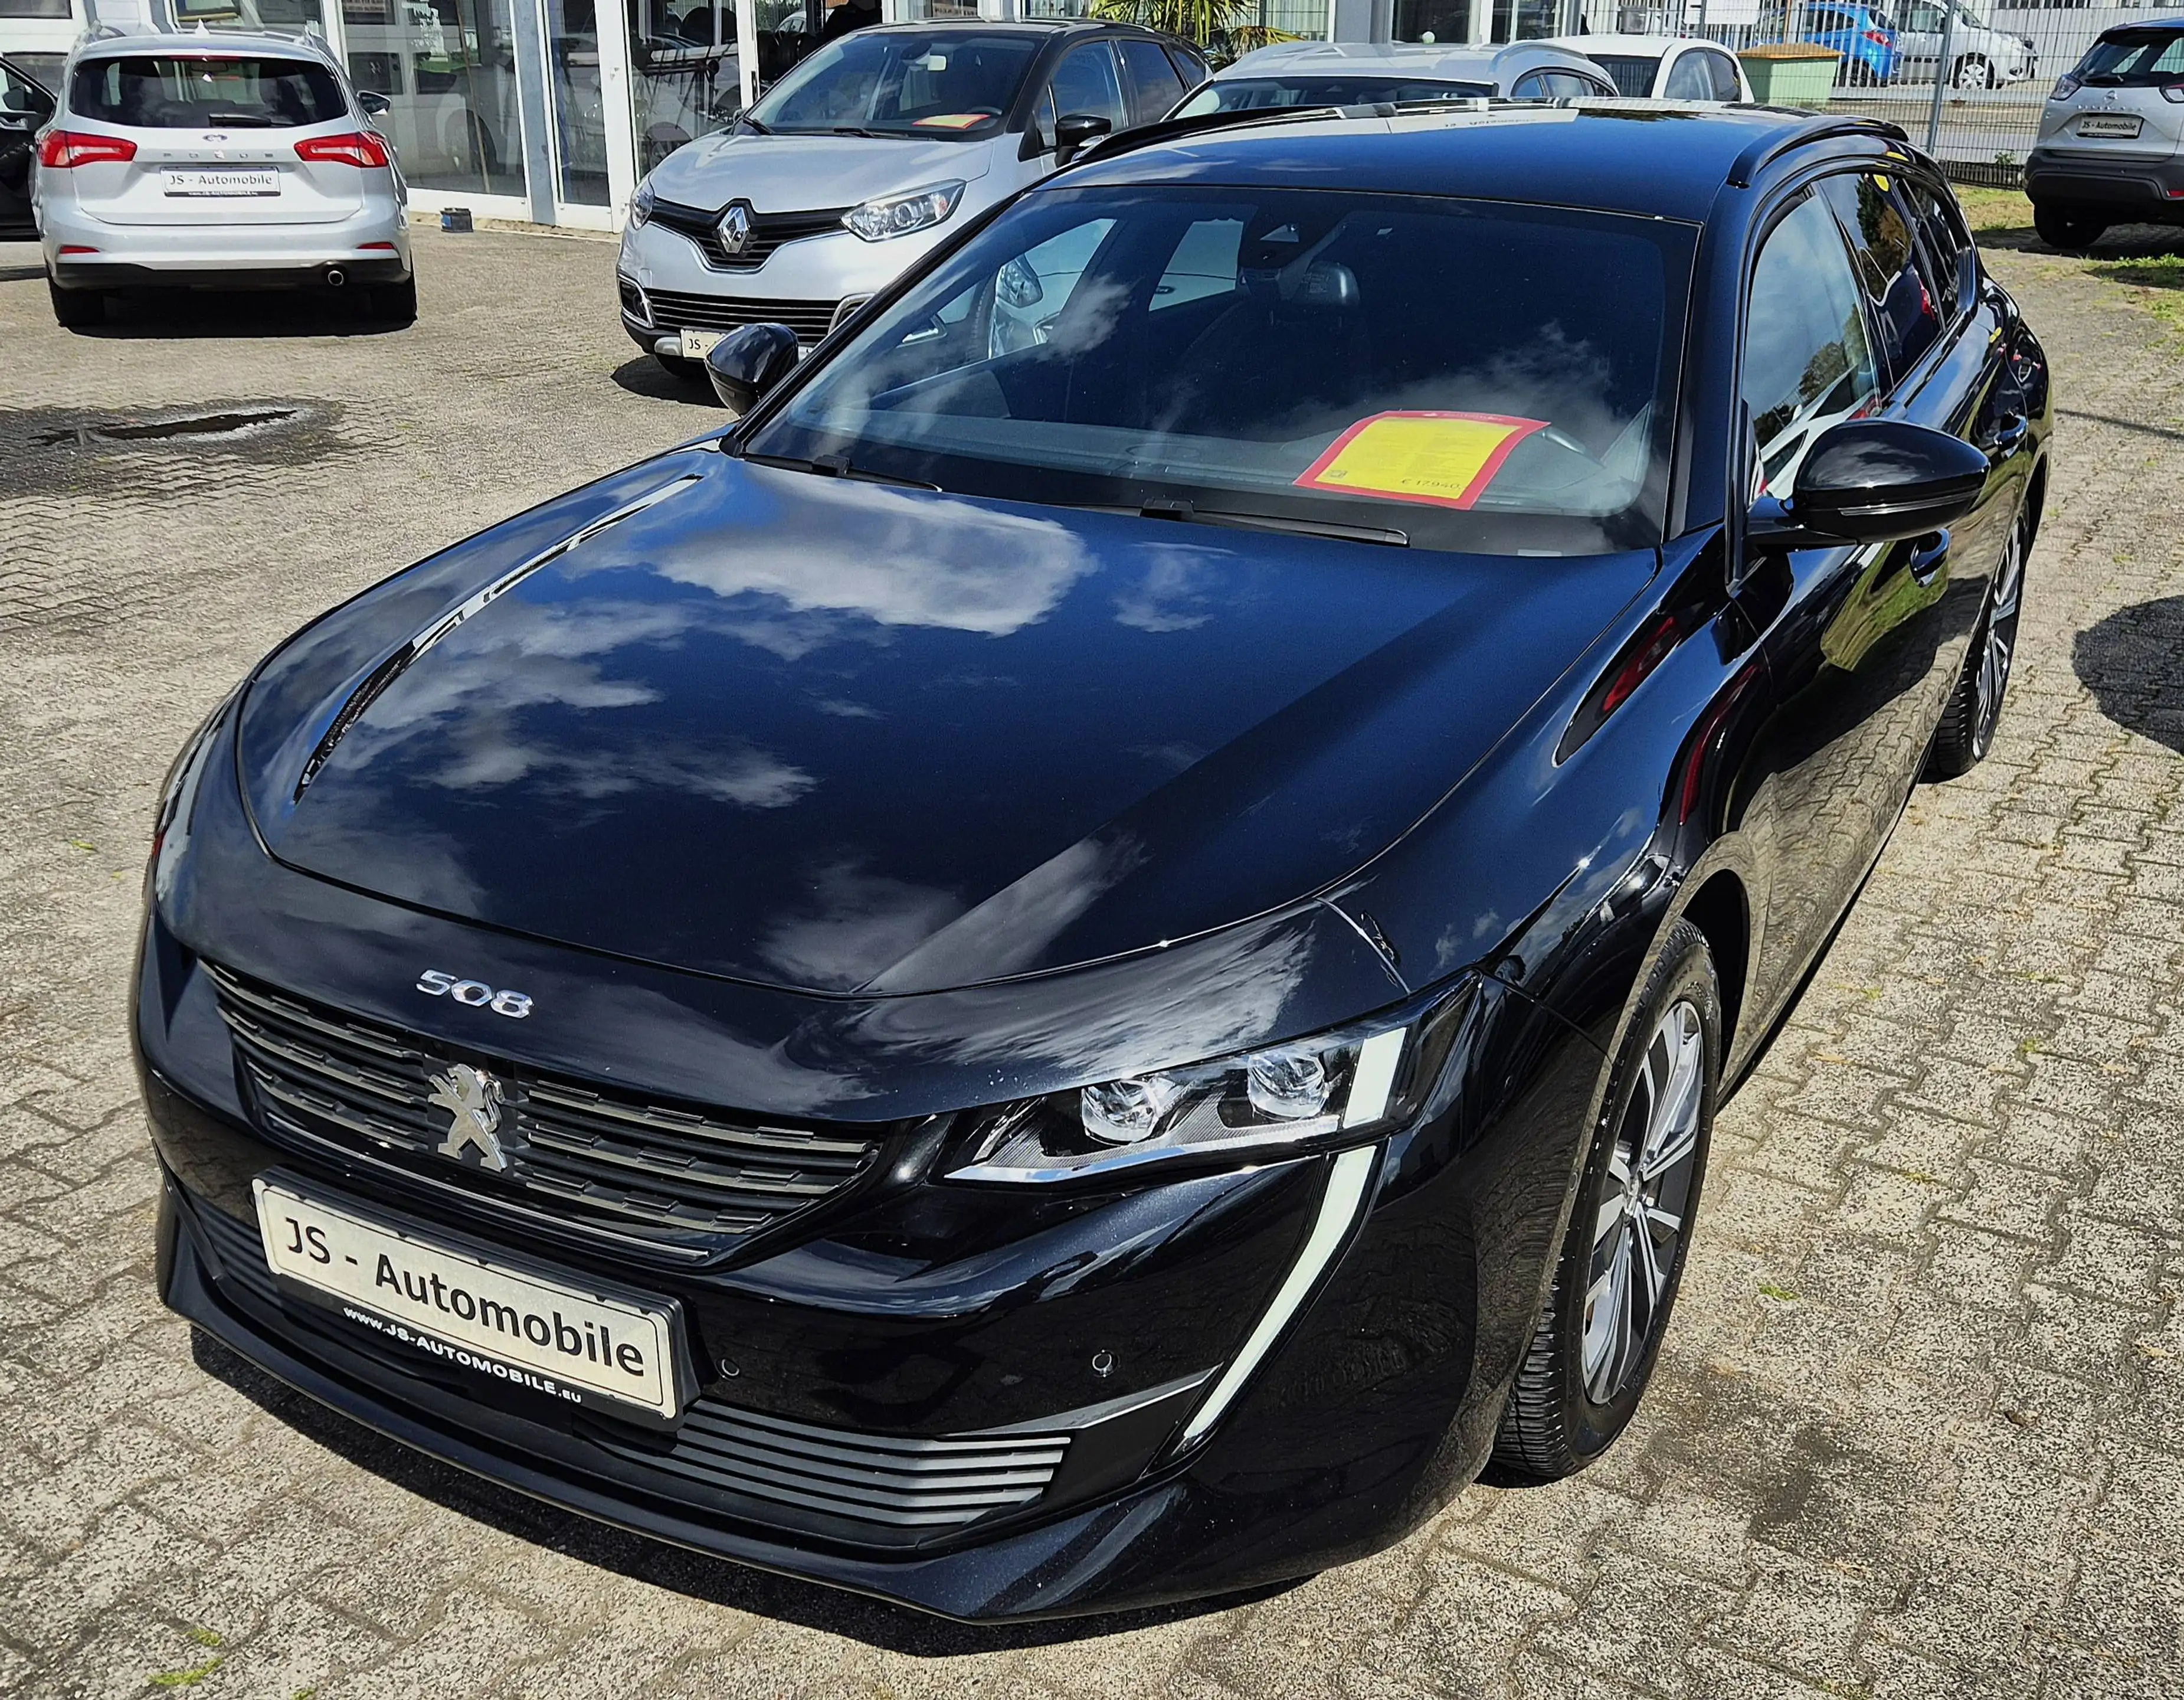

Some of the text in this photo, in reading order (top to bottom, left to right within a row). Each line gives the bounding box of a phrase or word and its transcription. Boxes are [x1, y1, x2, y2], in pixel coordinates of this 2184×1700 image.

[2096, 120, 2136, 130] Automobile
[170, 175, 184, 185] JS
[198, 174, 272, 185] Automobile
[689, 338, 701, 349] JS
[415, 969, 534, 1018] 508
[285, 1217, 644, 1377] JS - Automobile
